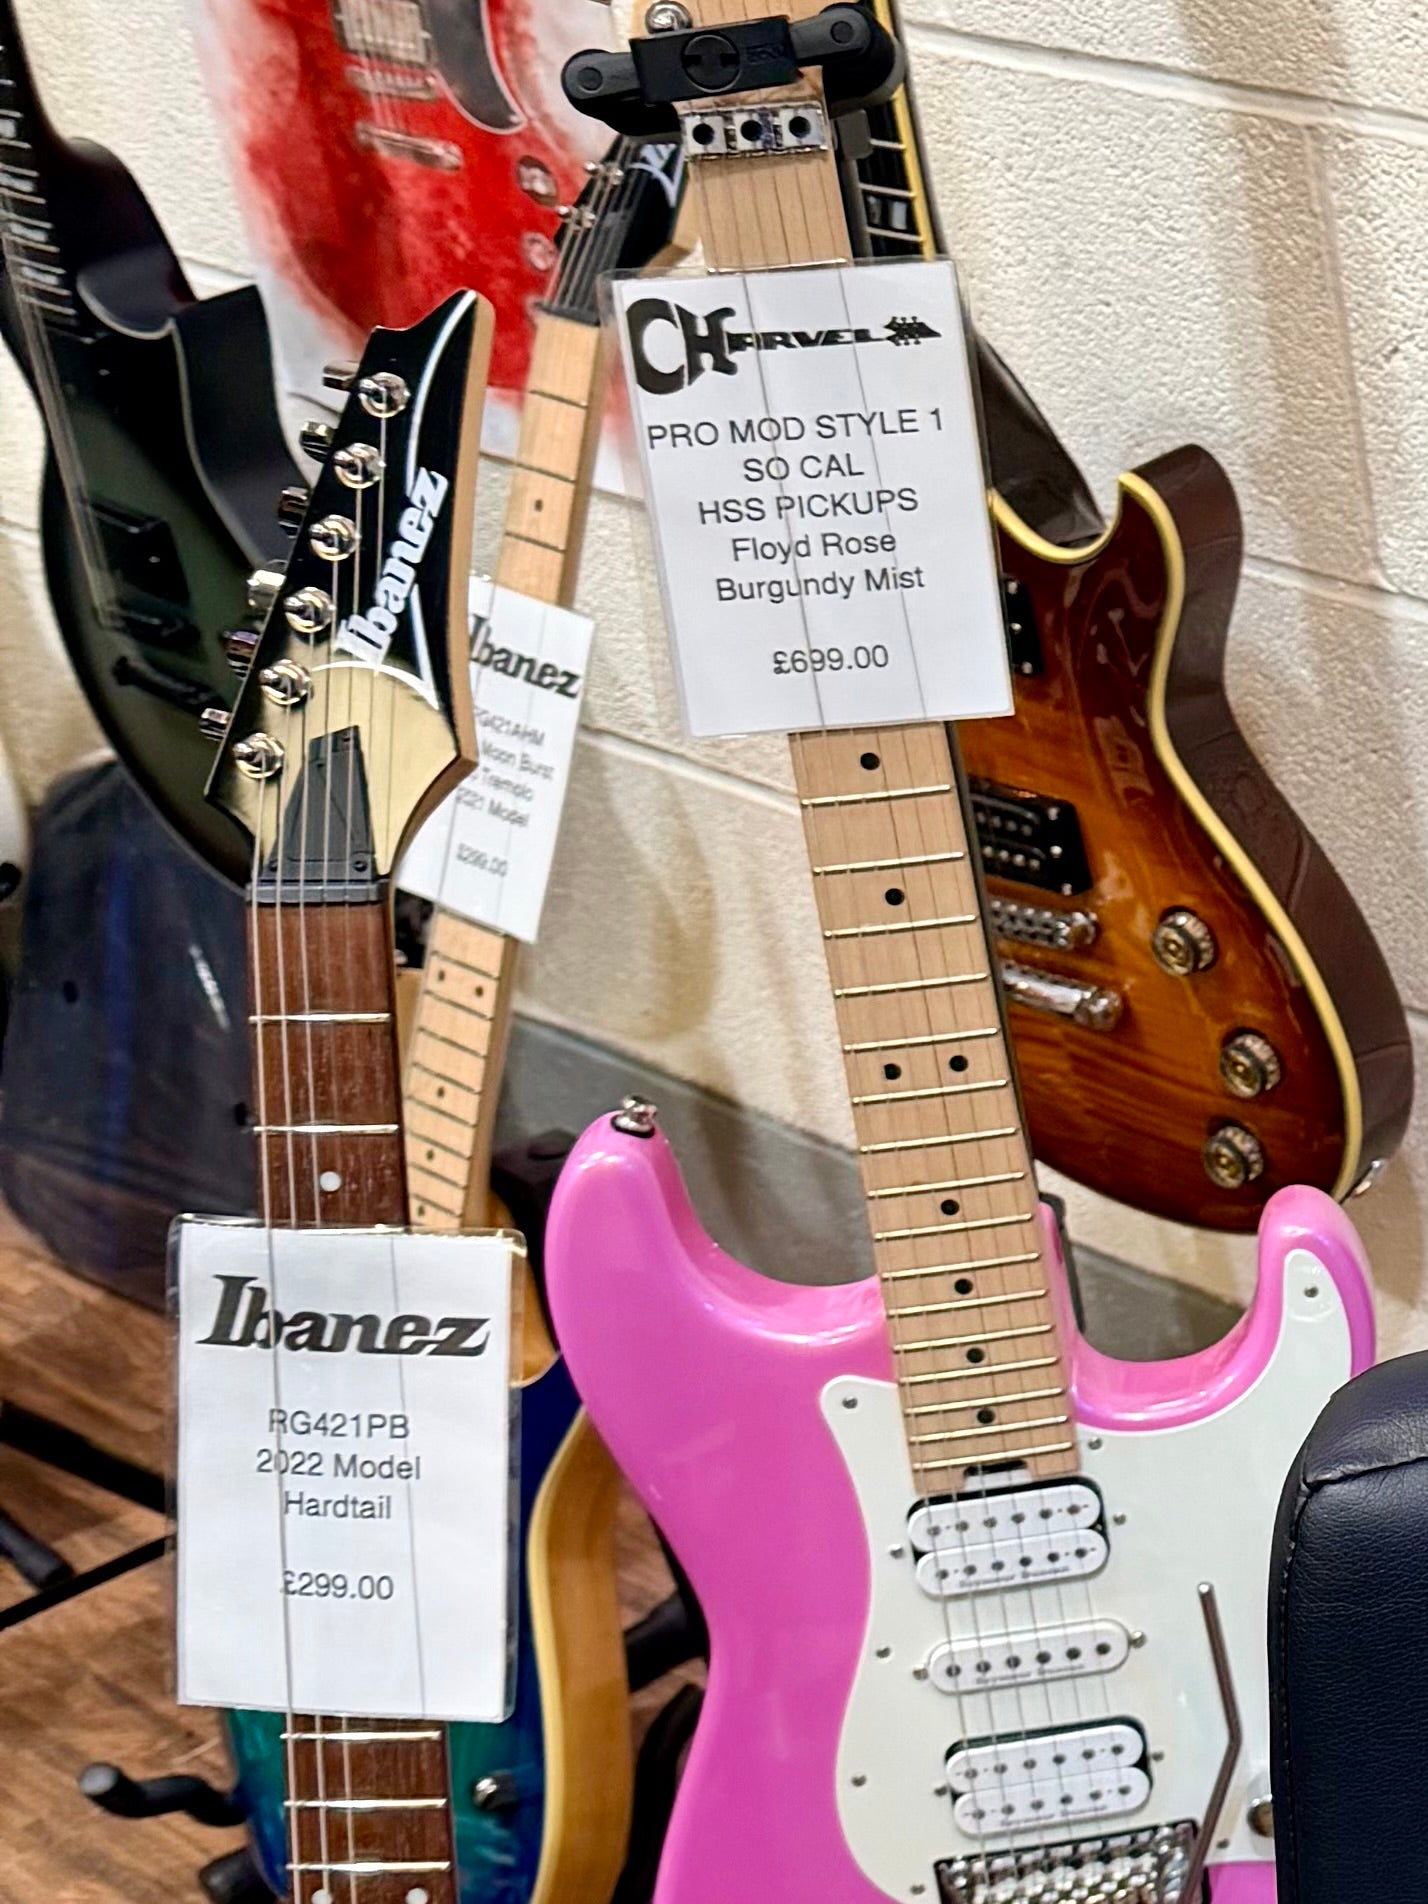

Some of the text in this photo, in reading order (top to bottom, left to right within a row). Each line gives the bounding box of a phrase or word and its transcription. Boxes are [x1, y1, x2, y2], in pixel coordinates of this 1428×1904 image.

[625, 297, 886, 395] CHARVEL
[647, 407, 944, 450] PRO MOD STYLE 1
[743, 452, 865, 483] SO CAL
[698, 487, 920, 525] HSS PICKUPS
[332, 465, 449, 666] Ibanez
[731, 530, 897, 566] Floyd Rose
[716, 565, 926, 604] Burgundy Mist
[469, 613, 581, 700] Ibanez
[772, 643, 889, 675] £699.00
[195, 1273, 492, 1358] Ibanez
[268, 1408, 410, 1439] RG421PB
[256, 1448, 421, 1480] 2022 Model
[284, 1490, 392, 1520] Hardtail
[281, 1569, 395, 1601] £299.00
